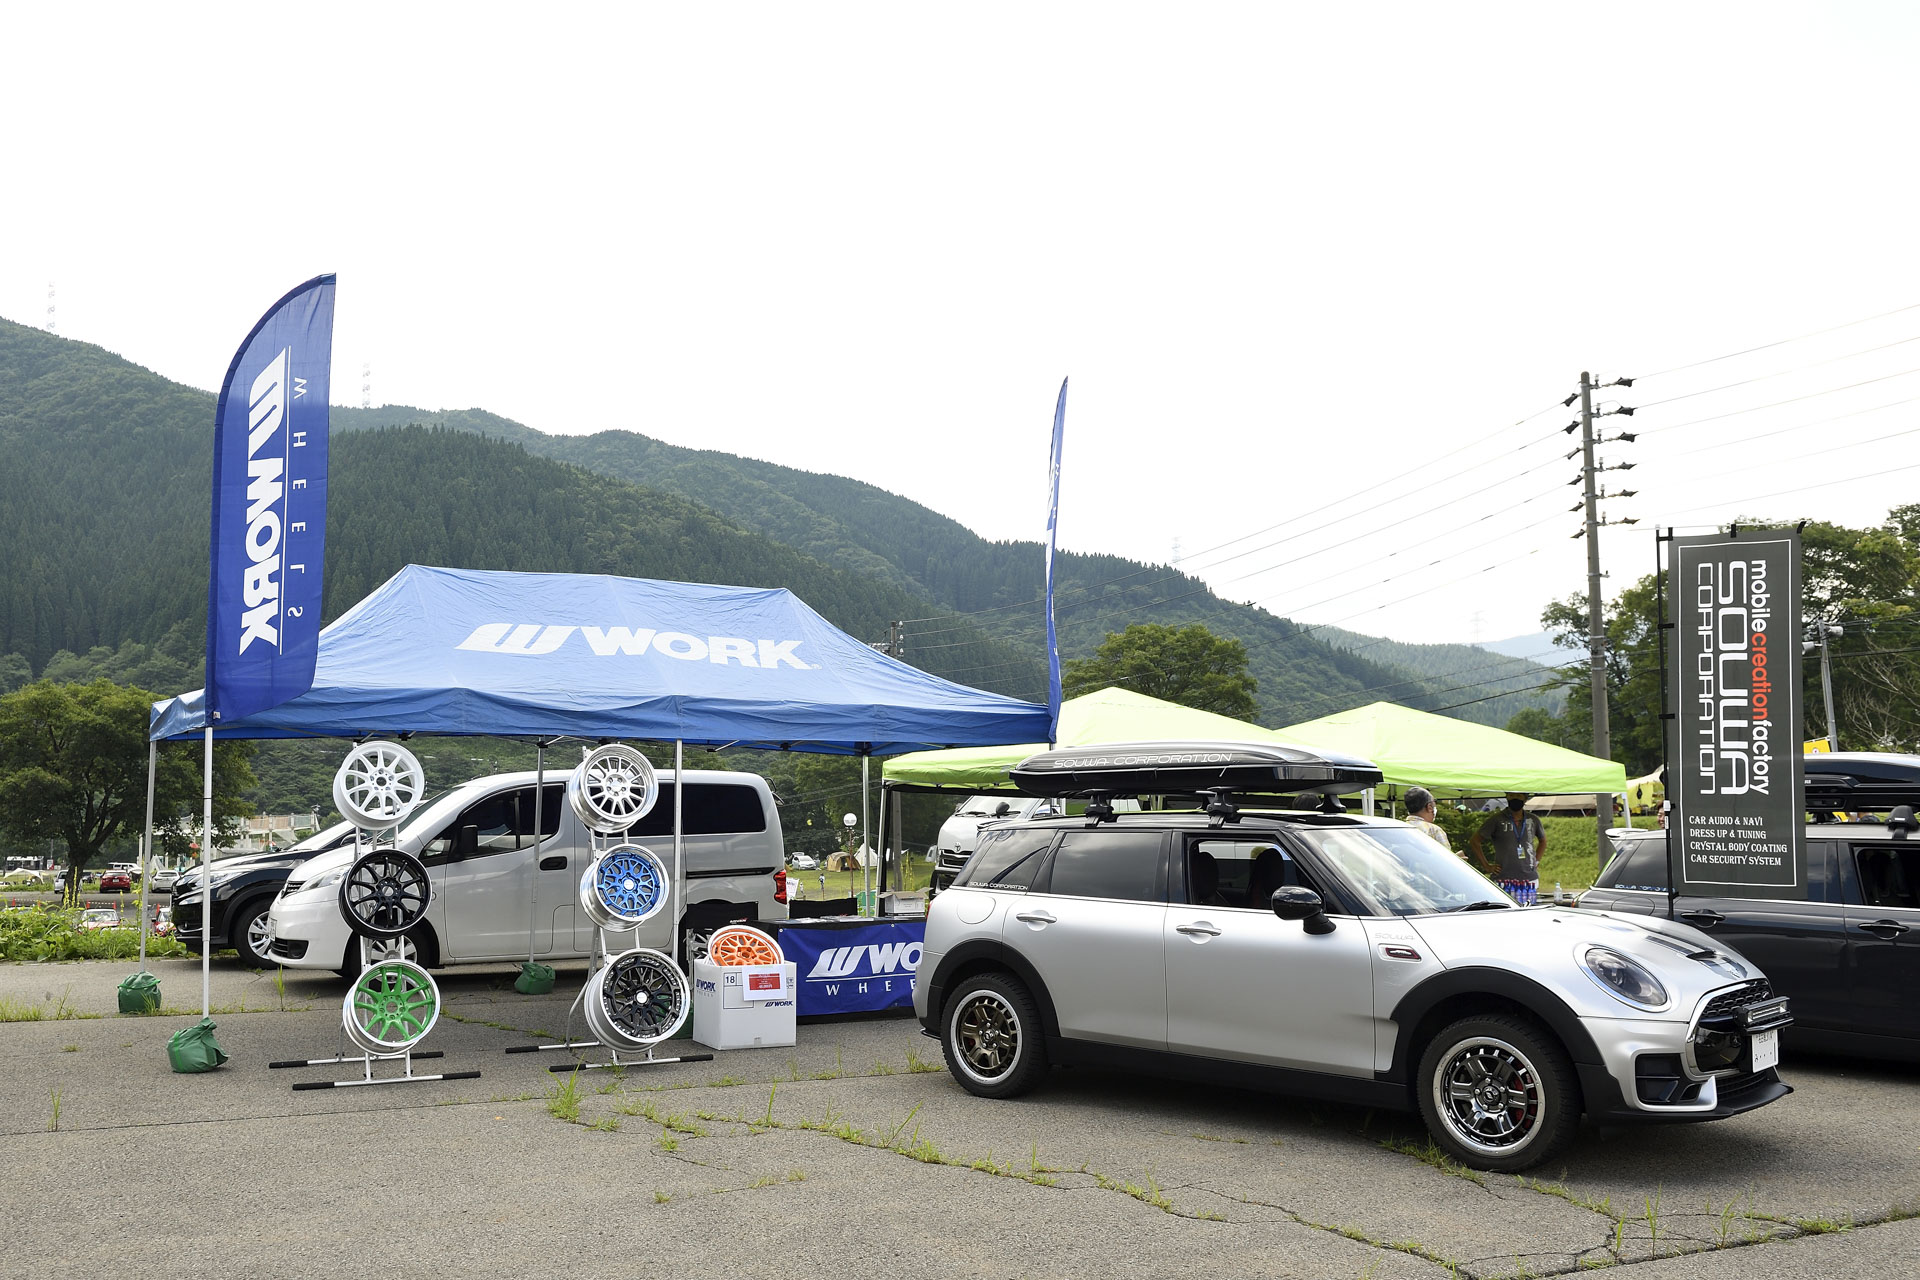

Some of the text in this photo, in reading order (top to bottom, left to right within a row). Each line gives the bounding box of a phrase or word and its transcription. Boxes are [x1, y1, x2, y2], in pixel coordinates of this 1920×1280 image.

[578, 626, 814, 670] WORK
[1718, 561, 1750, 795] SOUWA
[1052, 753, 1233, 769] SOUWA CORPORATION
[1689, 815, 1763, 826] CAR AUDIO & NAVI
[1690, 828, 1767, 840] DRESS UP & TUNING
[1690, 841, 1788, 853] CRYSTAL BODY COATING
[1690, 854, 1781, 866] CAR SECURITY SYSTEM
[725, 975, 736, 984] 18
